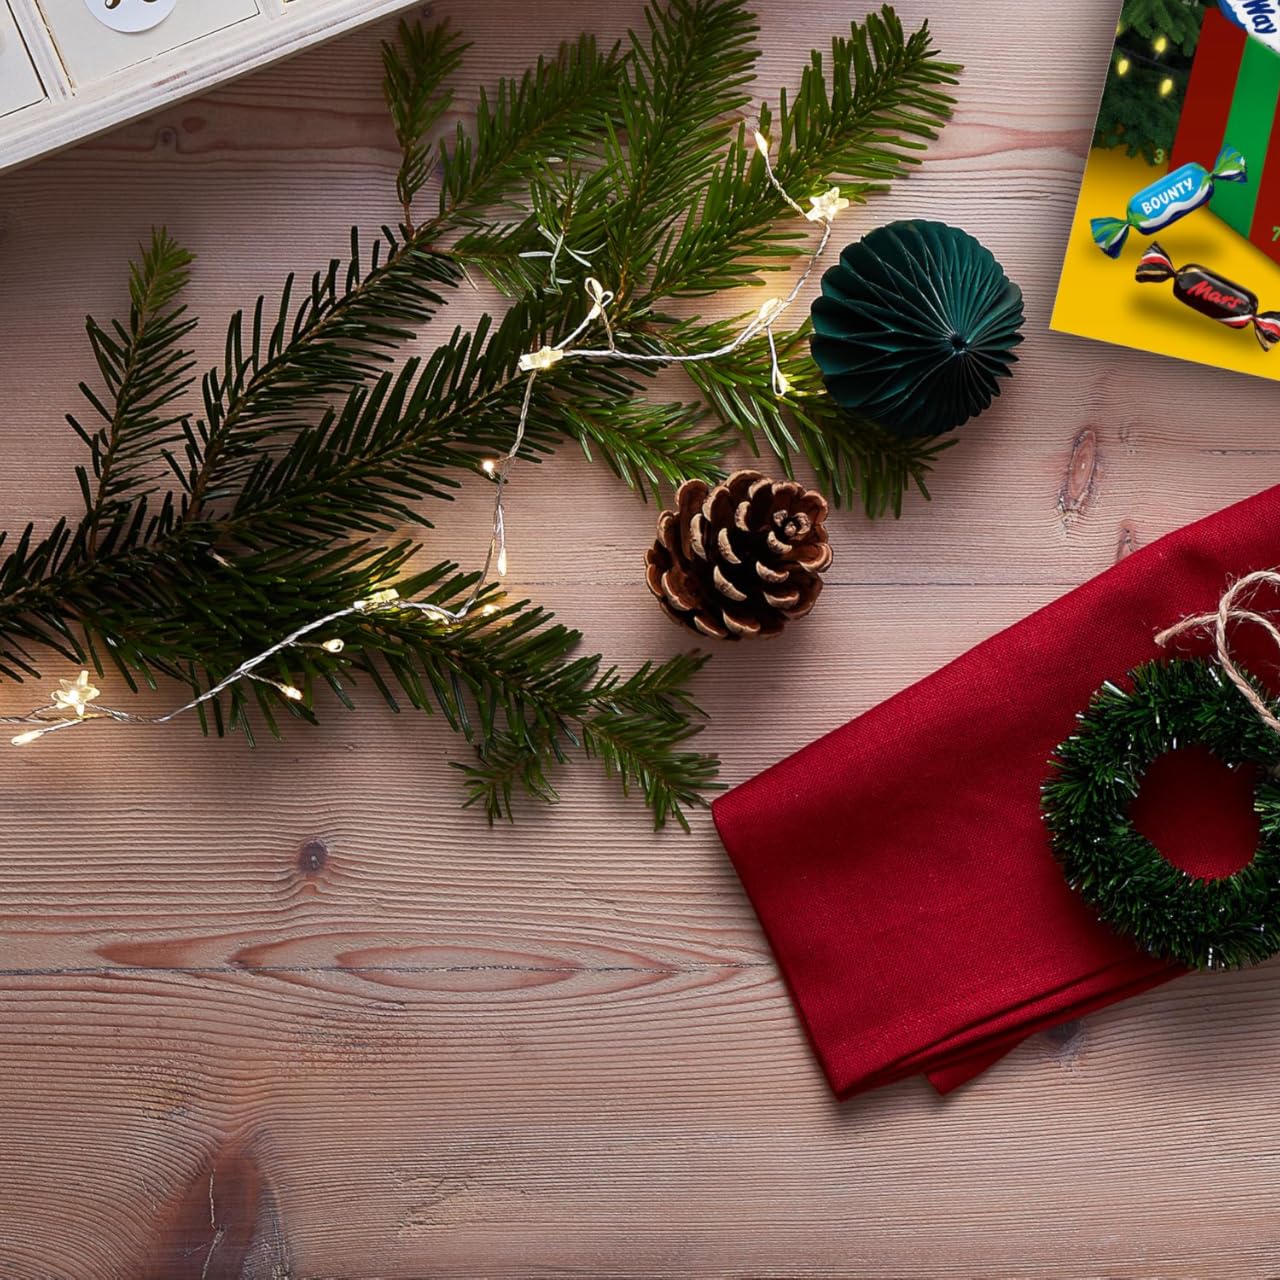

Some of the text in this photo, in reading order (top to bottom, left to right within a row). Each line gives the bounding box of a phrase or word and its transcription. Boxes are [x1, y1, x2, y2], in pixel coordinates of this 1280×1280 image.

[1153, 148, 1165, 164] 3
[1141, 177, 1194, 216] BOUNTY
[1186, 280, 1242, 310] Mars
